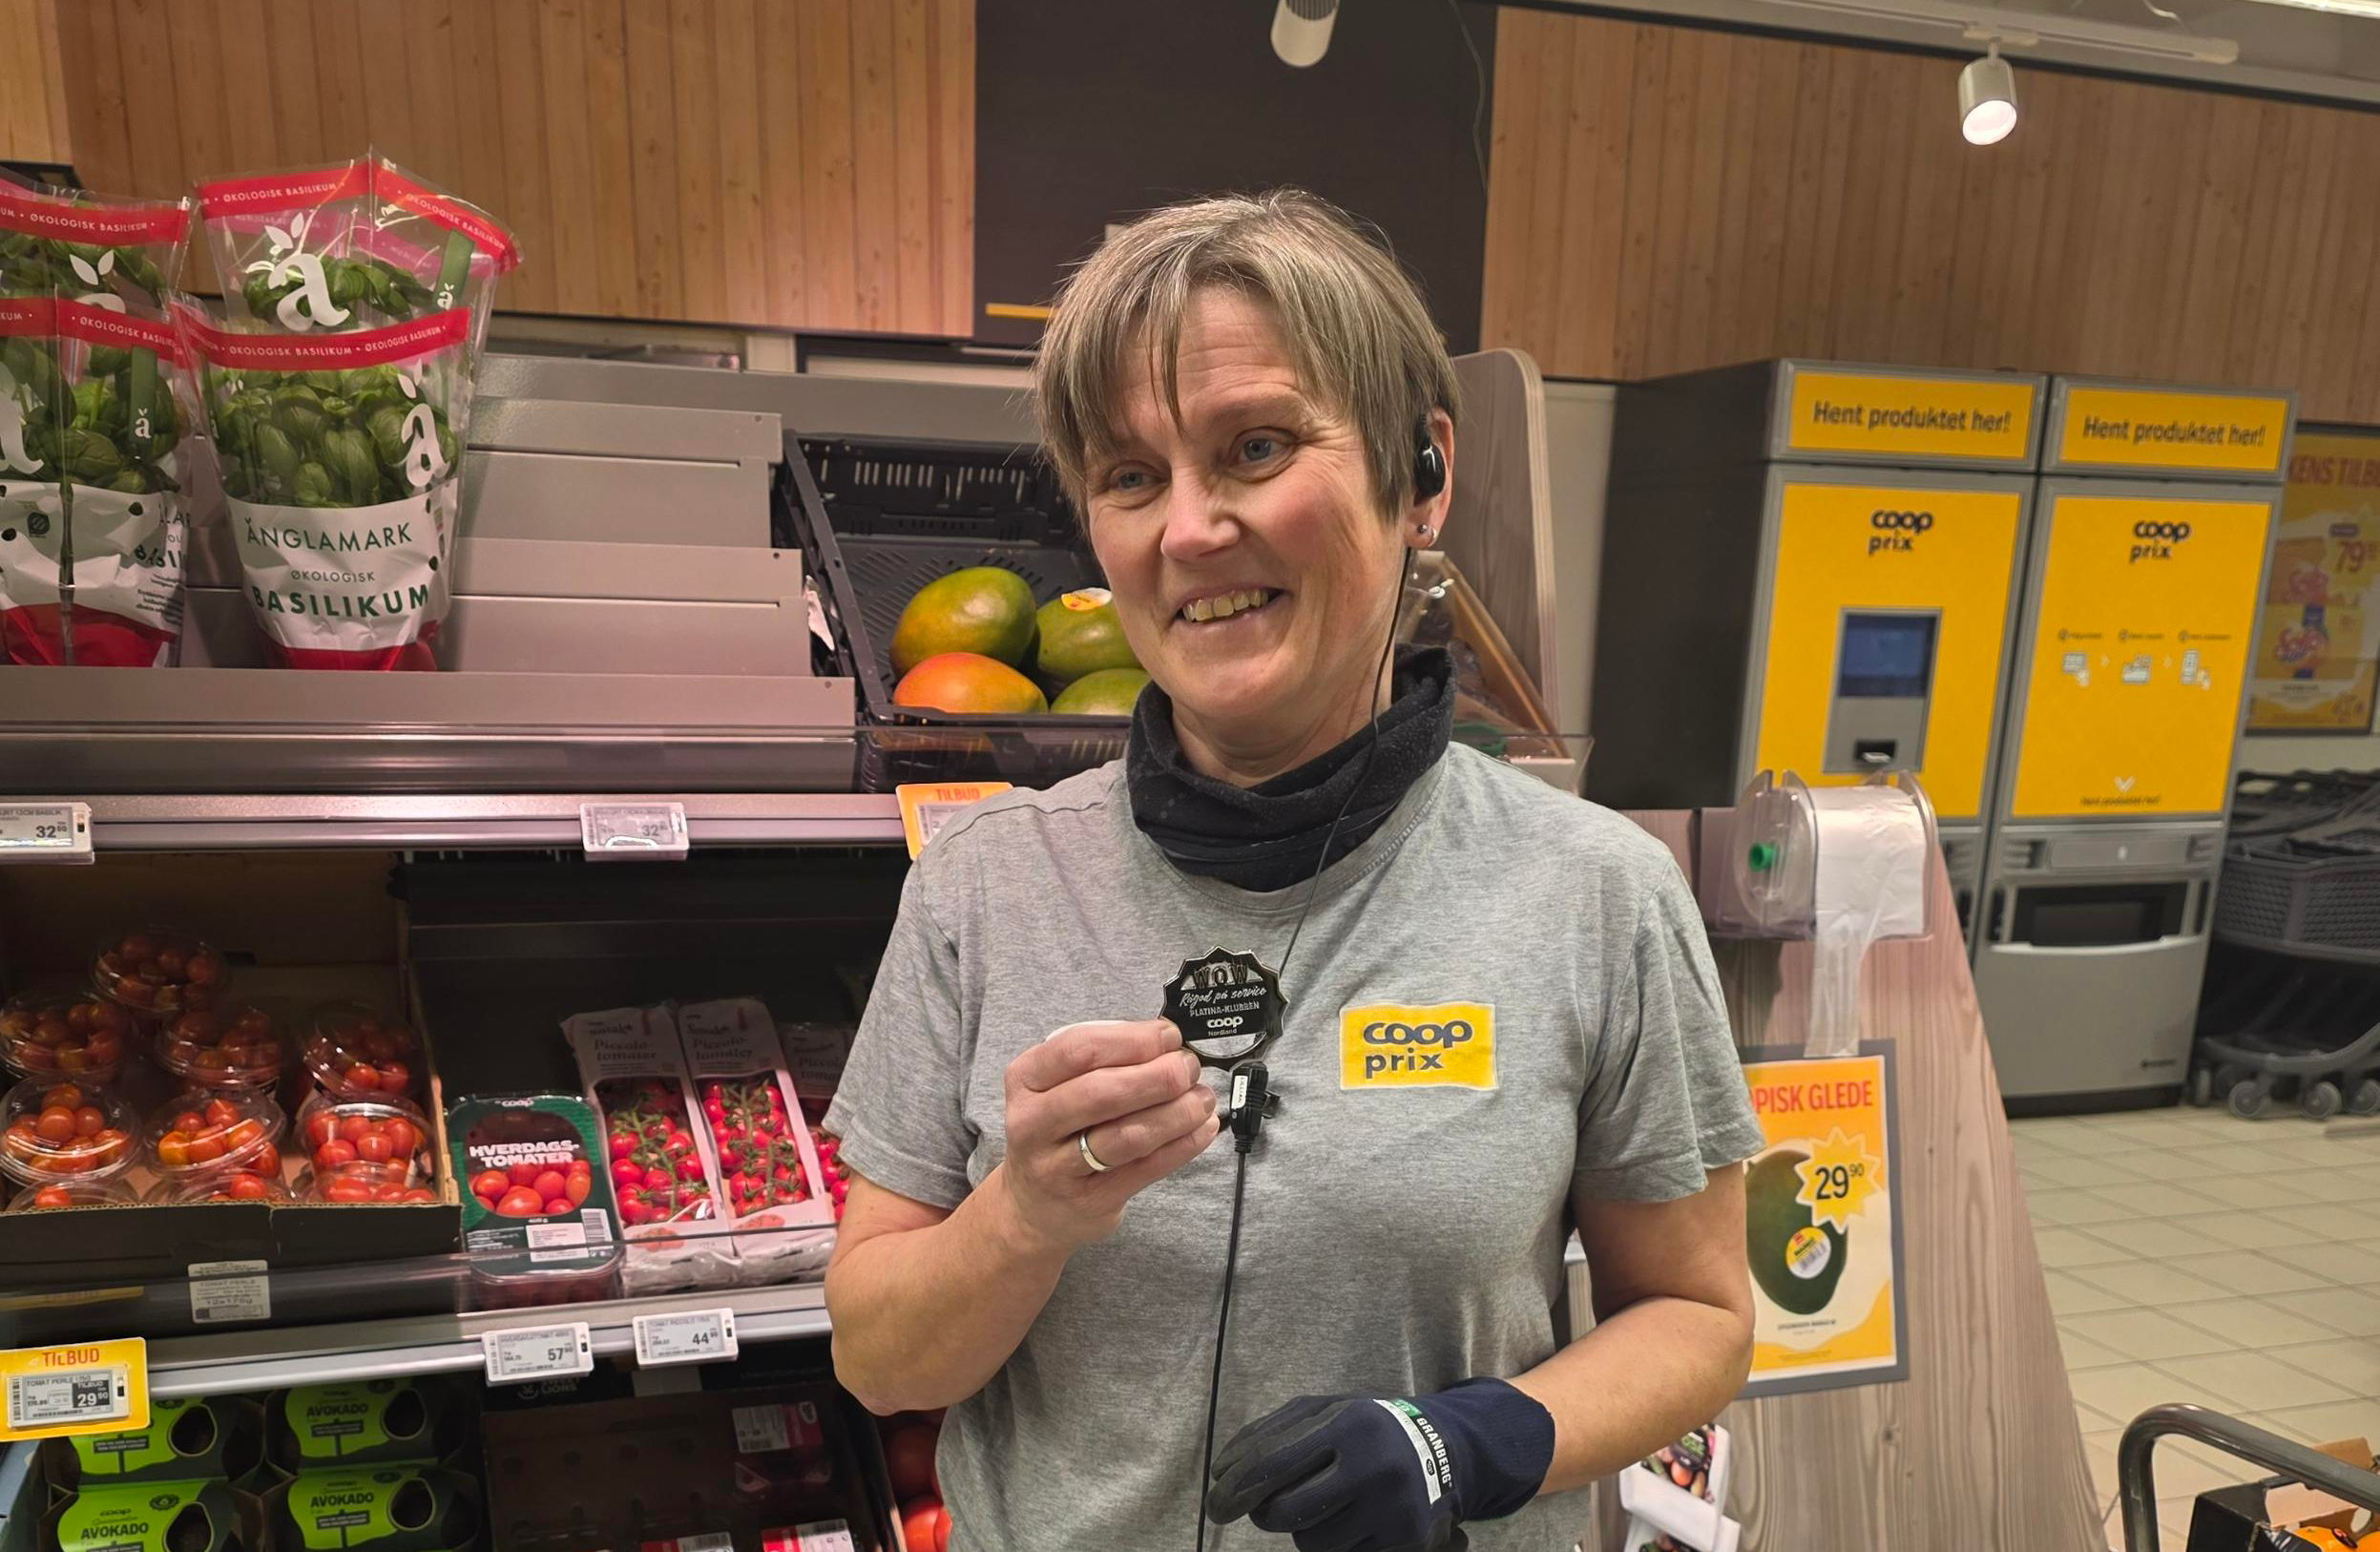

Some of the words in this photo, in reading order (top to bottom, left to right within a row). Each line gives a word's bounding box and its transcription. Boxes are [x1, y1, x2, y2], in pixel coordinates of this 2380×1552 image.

[30, 213, 95, 231] ØKOLOGISK
[229, 346, 291, 356] ØKOLOGISK
[295, 346, 352, 356] BASILIKUM
[1813, 400, 1863, 426] Hent
[1868, 406, 1967, 431] produktet
[1971, 409, 2013, 434] her!
[2082, 414, 2131, 440] Hent
[2133, 420, 2225, 446] produktet
[2228, 423, 2266, 448] her!
[1870, 509, 1933, 535] coop
[2133, 520, 2193, 545] coop
[1868, 530, 1914, 556] prix
[2129, 539, 2172, 565] prix
[291, 570, 375, 583] ØKOLOGISK
[252, 584, 429, 618] BASILIKUM
[936, 788, 980, 801] TILBUD
[35, 826, 57, 838] 32
[641, 825, 659, 836] 32
[1194, 964, 1249, 989] WOW
[1207, 1016, 1243, 1028] coop
[1208, 1028, 1238, 1037] Nordland
[1363, 1020, 1472, 1048] coop
[1365, 1047, 1444, 1079] prix
[502, 1099, 534, 1107] coop
[1750, 1085, 1805, 1115] PISK
[1809, 1080, 1873, 1111] GLEDE
[470, 1140, 579, 1157] HVERDAGS-
[481, 1152, 573, 1168] TOMATER
[1815, 1164, 1849, 1200] 29
[692, 1332, 709, 1346] 44
[42, 1348, 100, 1367] TILBUD
[548, 1348, 563, 1361] 57
[77, 1393, 97, 1408] 29
[306, 1403, 368, 1416] AVOKADO
[311, 1492, 374, 1507] AVOKADO
[80, 1522, 149, 1540] AVOKADO
